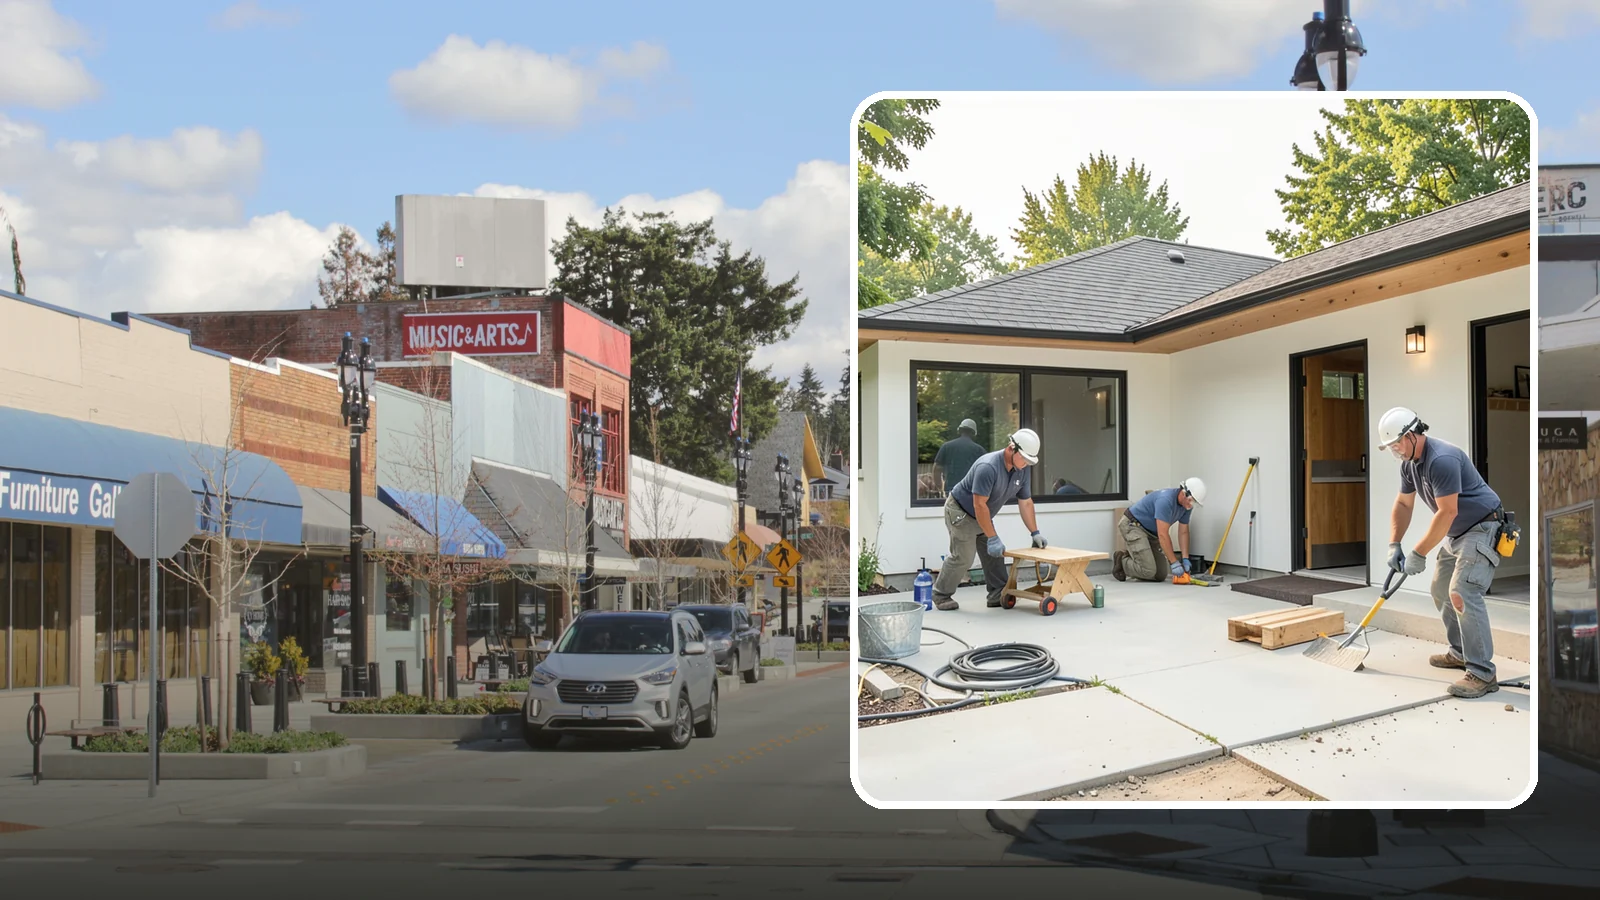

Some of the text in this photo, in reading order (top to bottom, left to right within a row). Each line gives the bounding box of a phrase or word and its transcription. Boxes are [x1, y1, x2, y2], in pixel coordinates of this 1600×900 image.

[409, 323, 519, 348] MUSIC&ARTS
[0, 472, 121, 519] Furniture Gal
